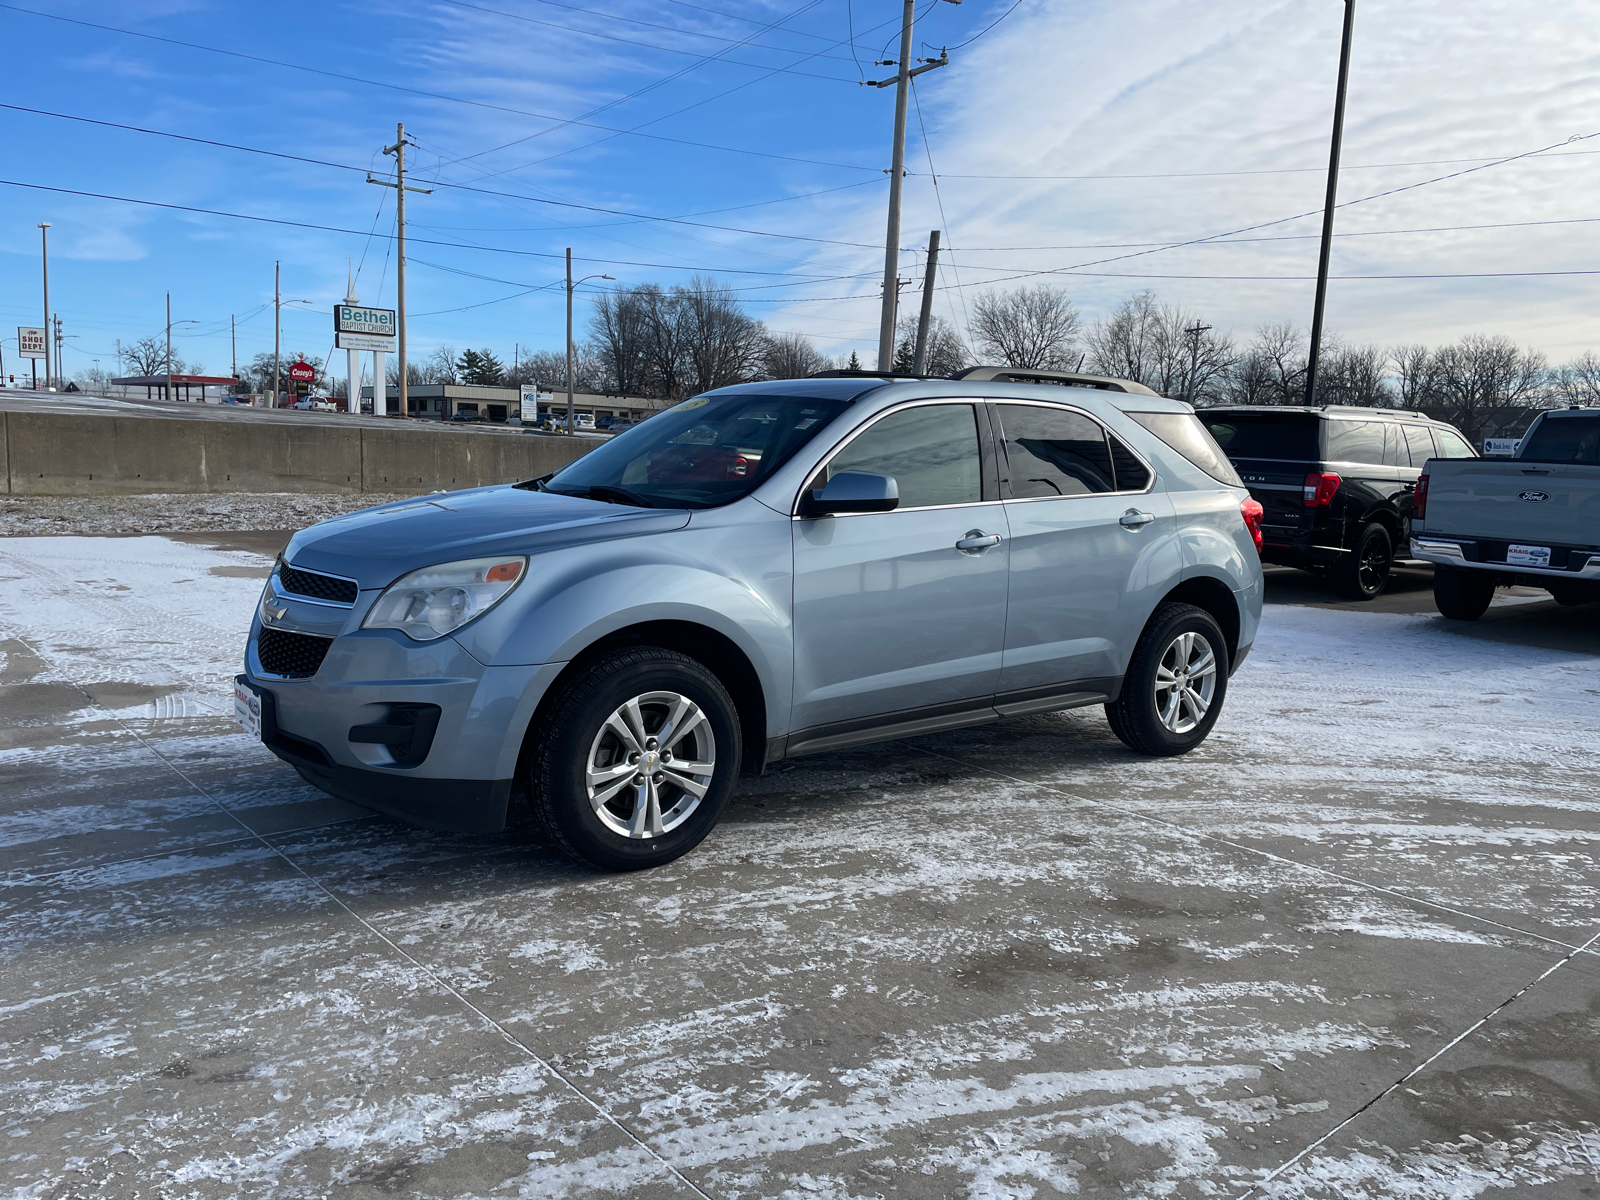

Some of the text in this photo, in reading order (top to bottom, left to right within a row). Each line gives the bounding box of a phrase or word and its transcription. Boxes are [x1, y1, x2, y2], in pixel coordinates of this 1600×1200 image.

[341, 308, 393, 325] Bethel
[341, 321, 393, 334] BAPTIST CHURCH
[292, 369, 313, 378] Casey's
[1522, 492, 1545, 500] Ford
